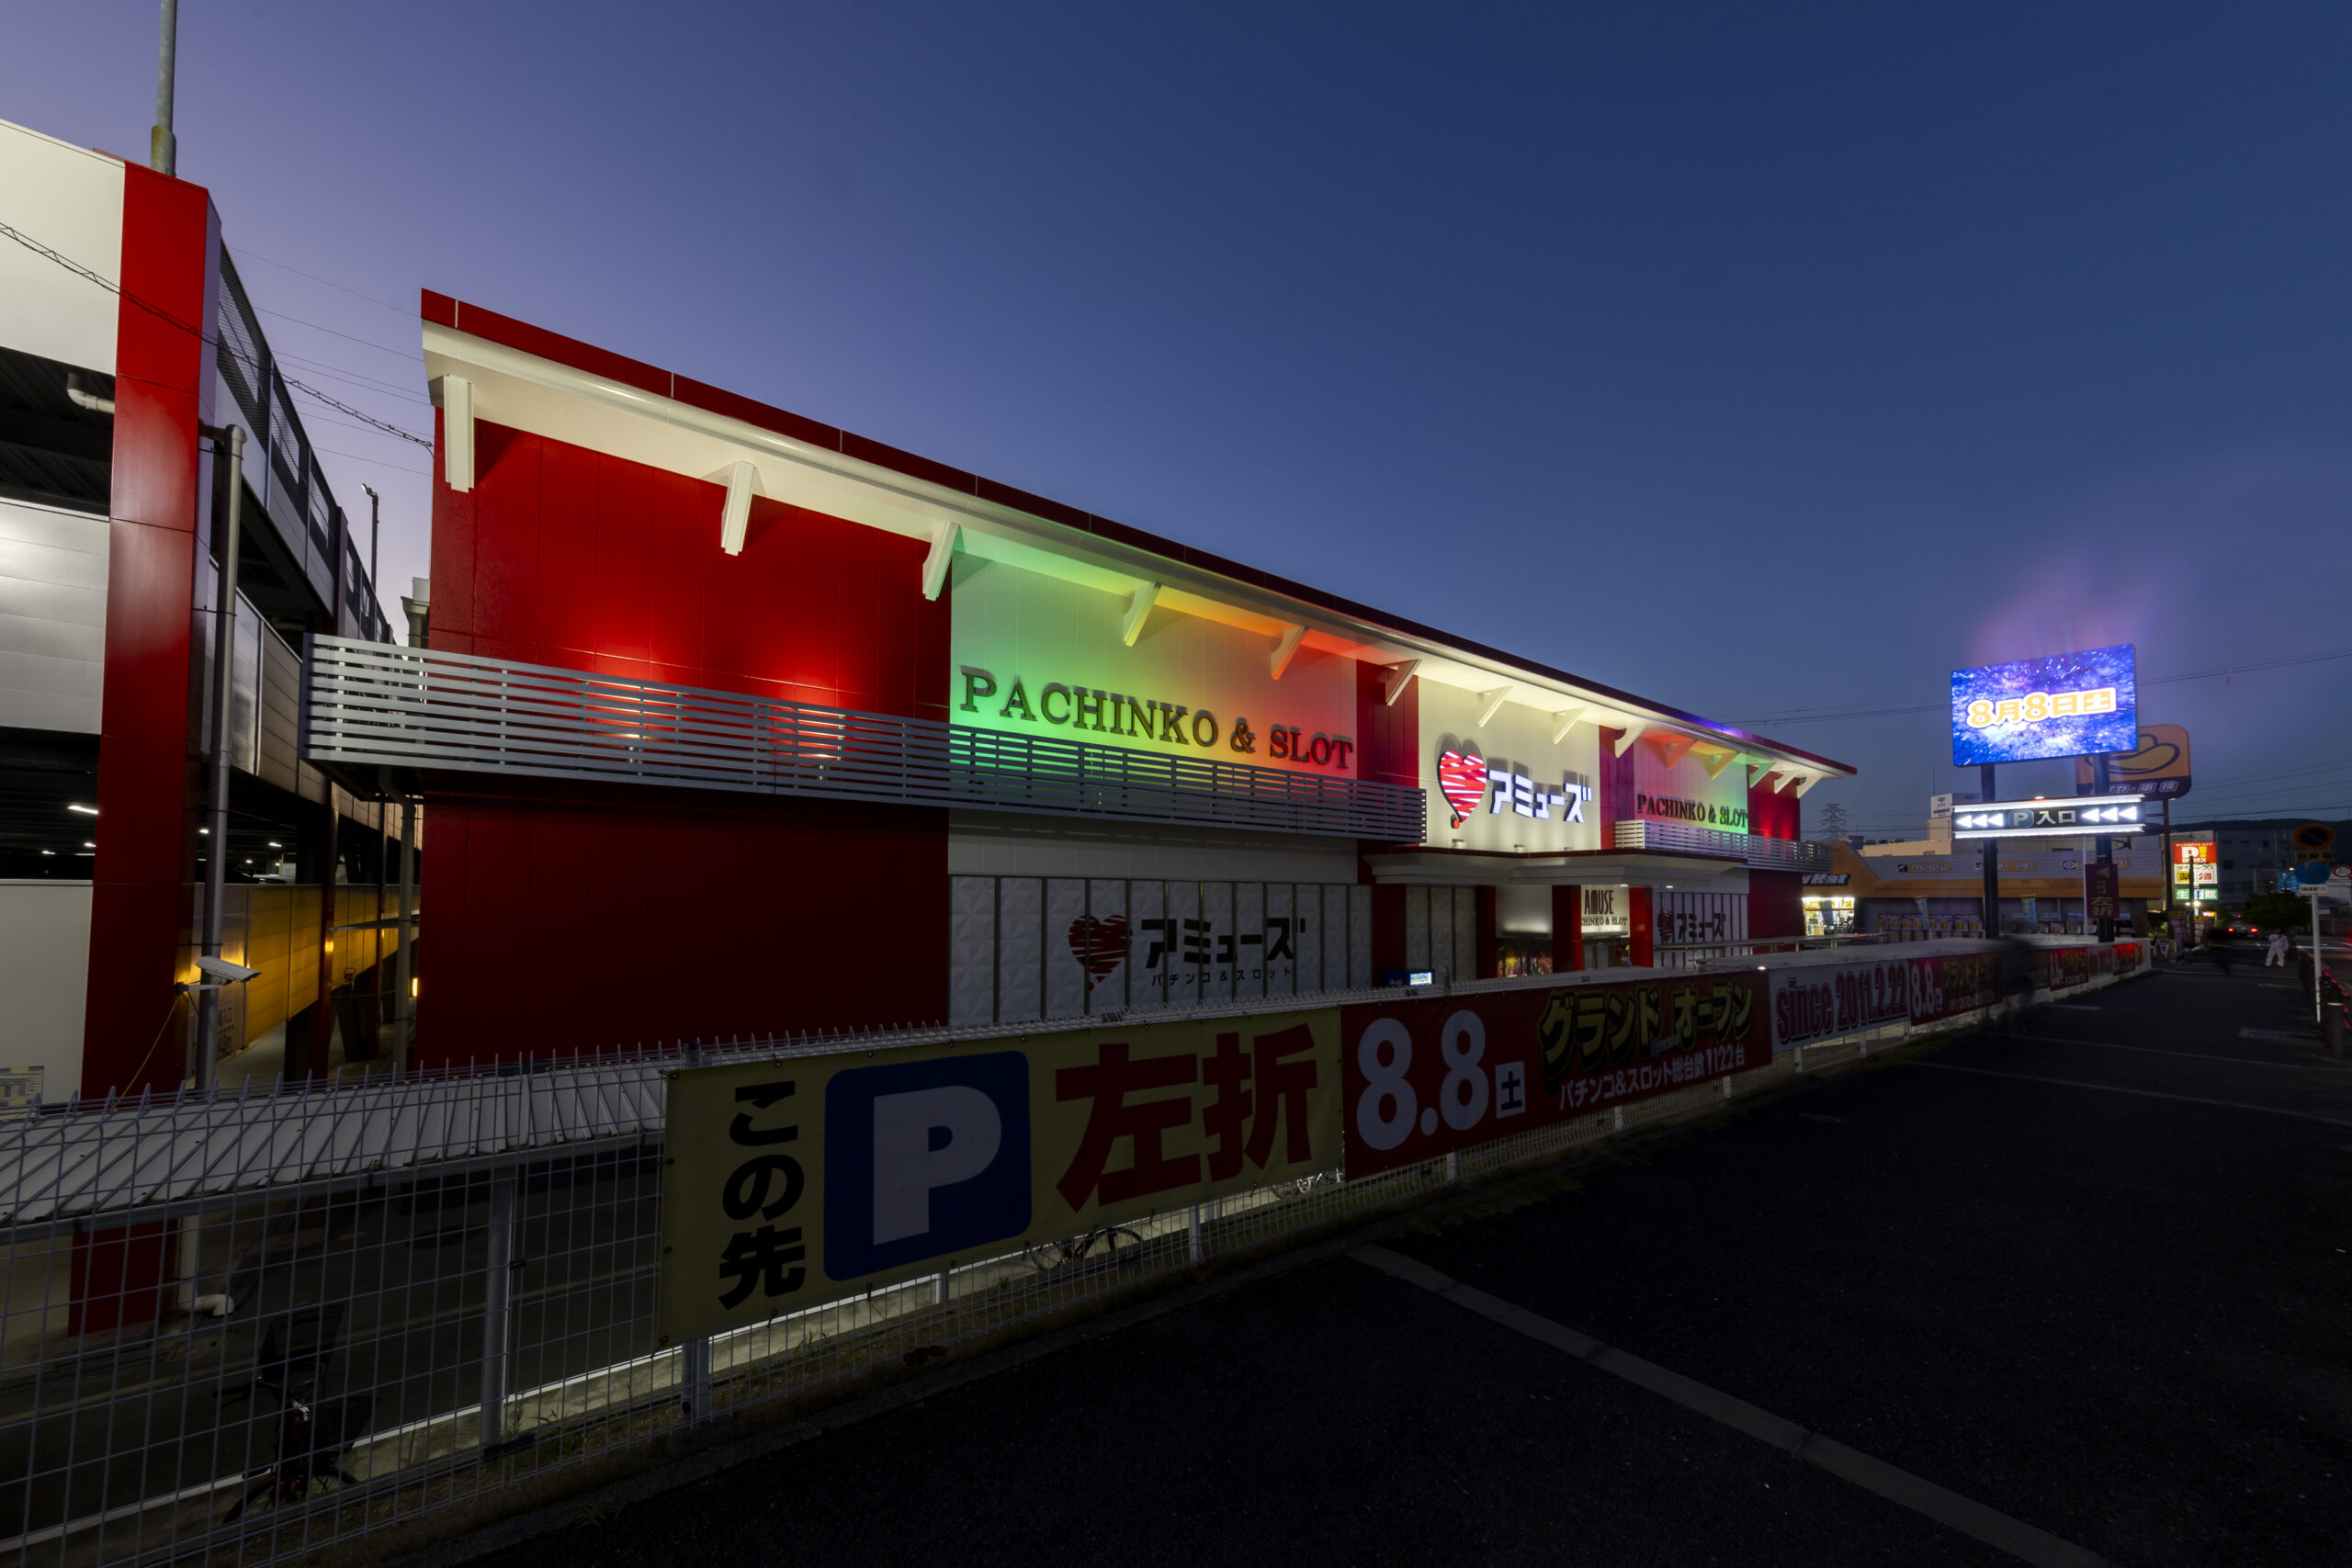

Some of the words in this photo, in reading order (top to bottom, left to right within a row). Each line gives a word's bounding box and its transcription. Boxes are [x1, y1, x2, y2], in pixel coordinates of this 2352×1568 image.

[959, 668, 1220, 748] PACHINKO
[1230, 721, 1255, 755] &
[1270, 728, 1354, 769] SLOT
[1486, 769, 1593, 824] アミューズ
[1636, 794, 1706, 822] PACHINKO
[1708, 806, 1716, 824] &
[1719, 807, 1748, 828] SLOT
[2013, 813, 2029, 826] P
[2036, 810, 2076, 826] 入口
[1584, 889, 1614, 915] AMUSE
[1611, 917, 1628, 926] SLOT
[1676, 912, 1726, 940] アミューズ
[1142, 918, 1306, 969] アミューズ
[1541, 986, 1661, 1071] グランド
[1672, 980, 1753, 1043] オープン
[1776, 977, 1834, 1044] since
[1836, 964, 1909, 1032] 2011.2.22
[1356, 1010, 1489, 1151] 8.8
[1498, 1067, 1524, 1113] 土
[1056, 1022, 1318, 1213] 左折
[718, 1079, 806, 1310] この先
[873, 1085, 1002, 1246] P
